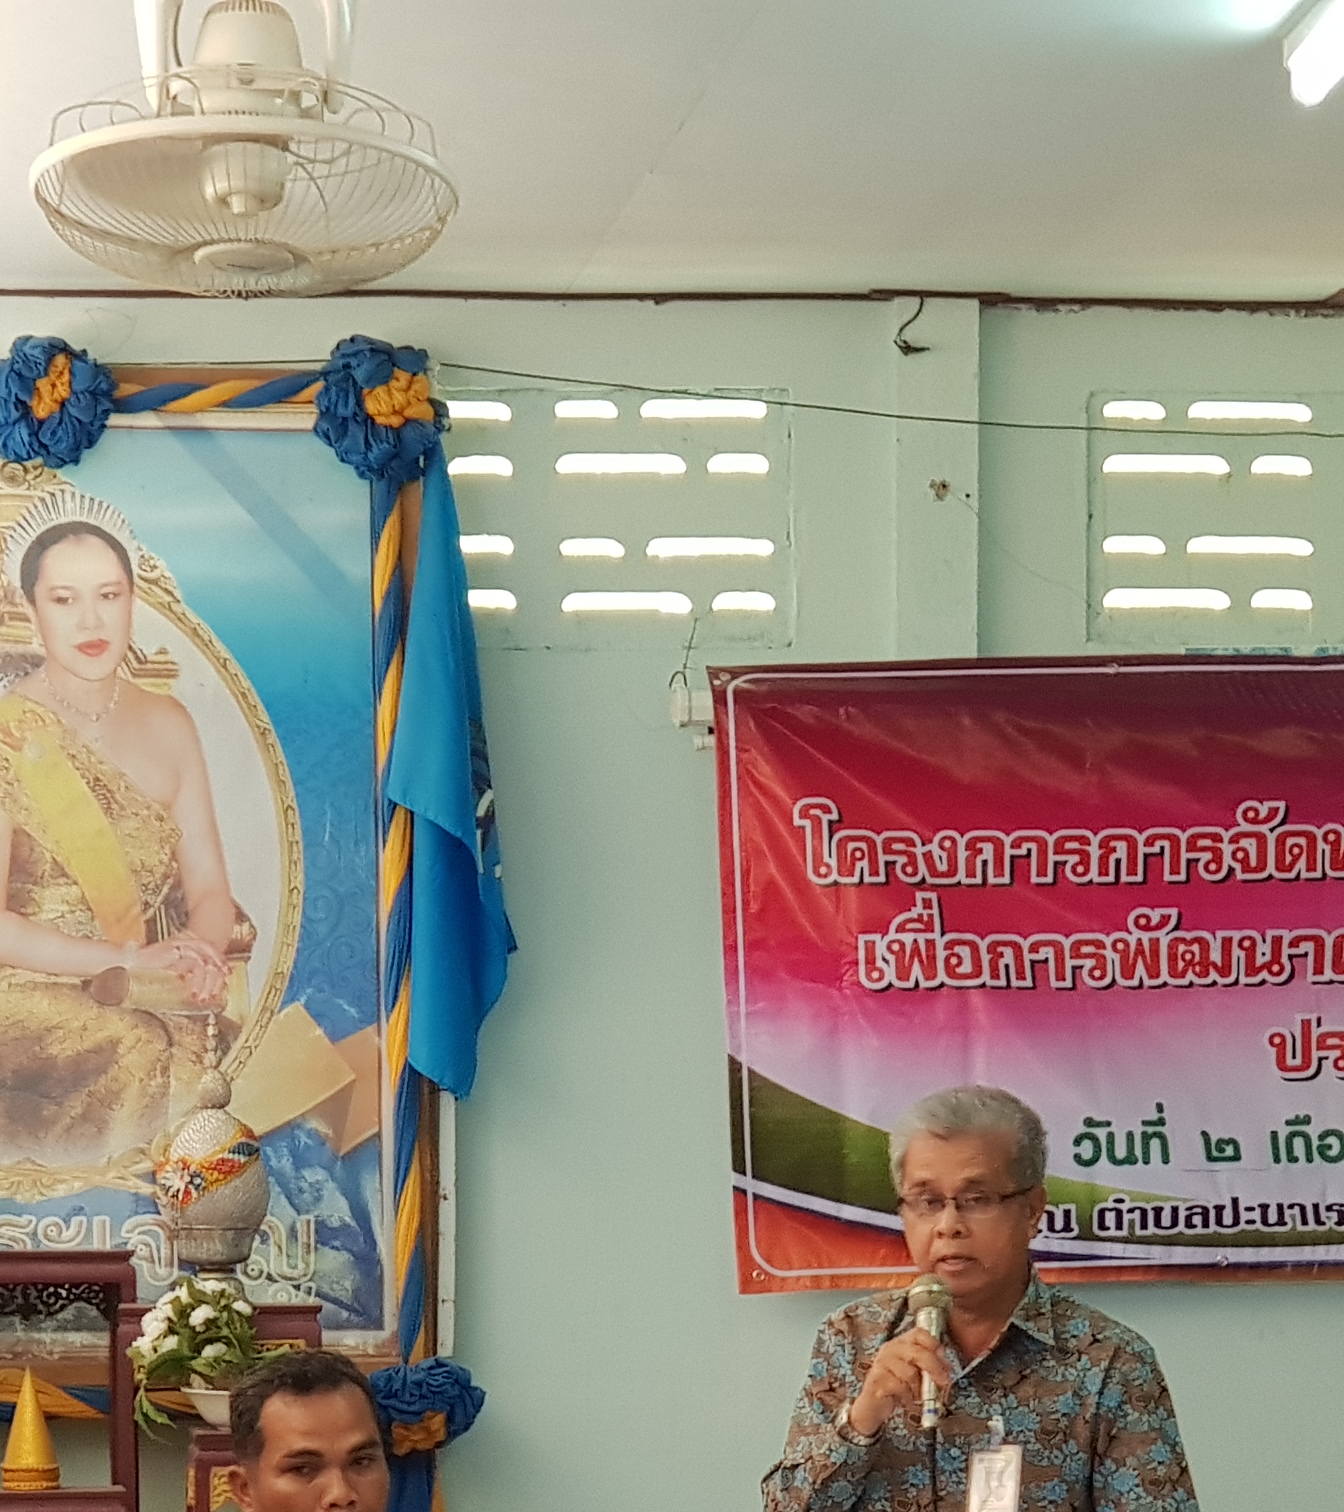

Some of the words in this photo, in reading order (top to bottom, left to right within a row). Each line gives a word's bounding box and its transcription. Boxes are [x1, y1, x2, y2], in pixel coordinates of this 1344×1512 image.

[1072, 1102, 1170, 1166] วันที่
[1201, 1129, 1242, 1162] ๒
